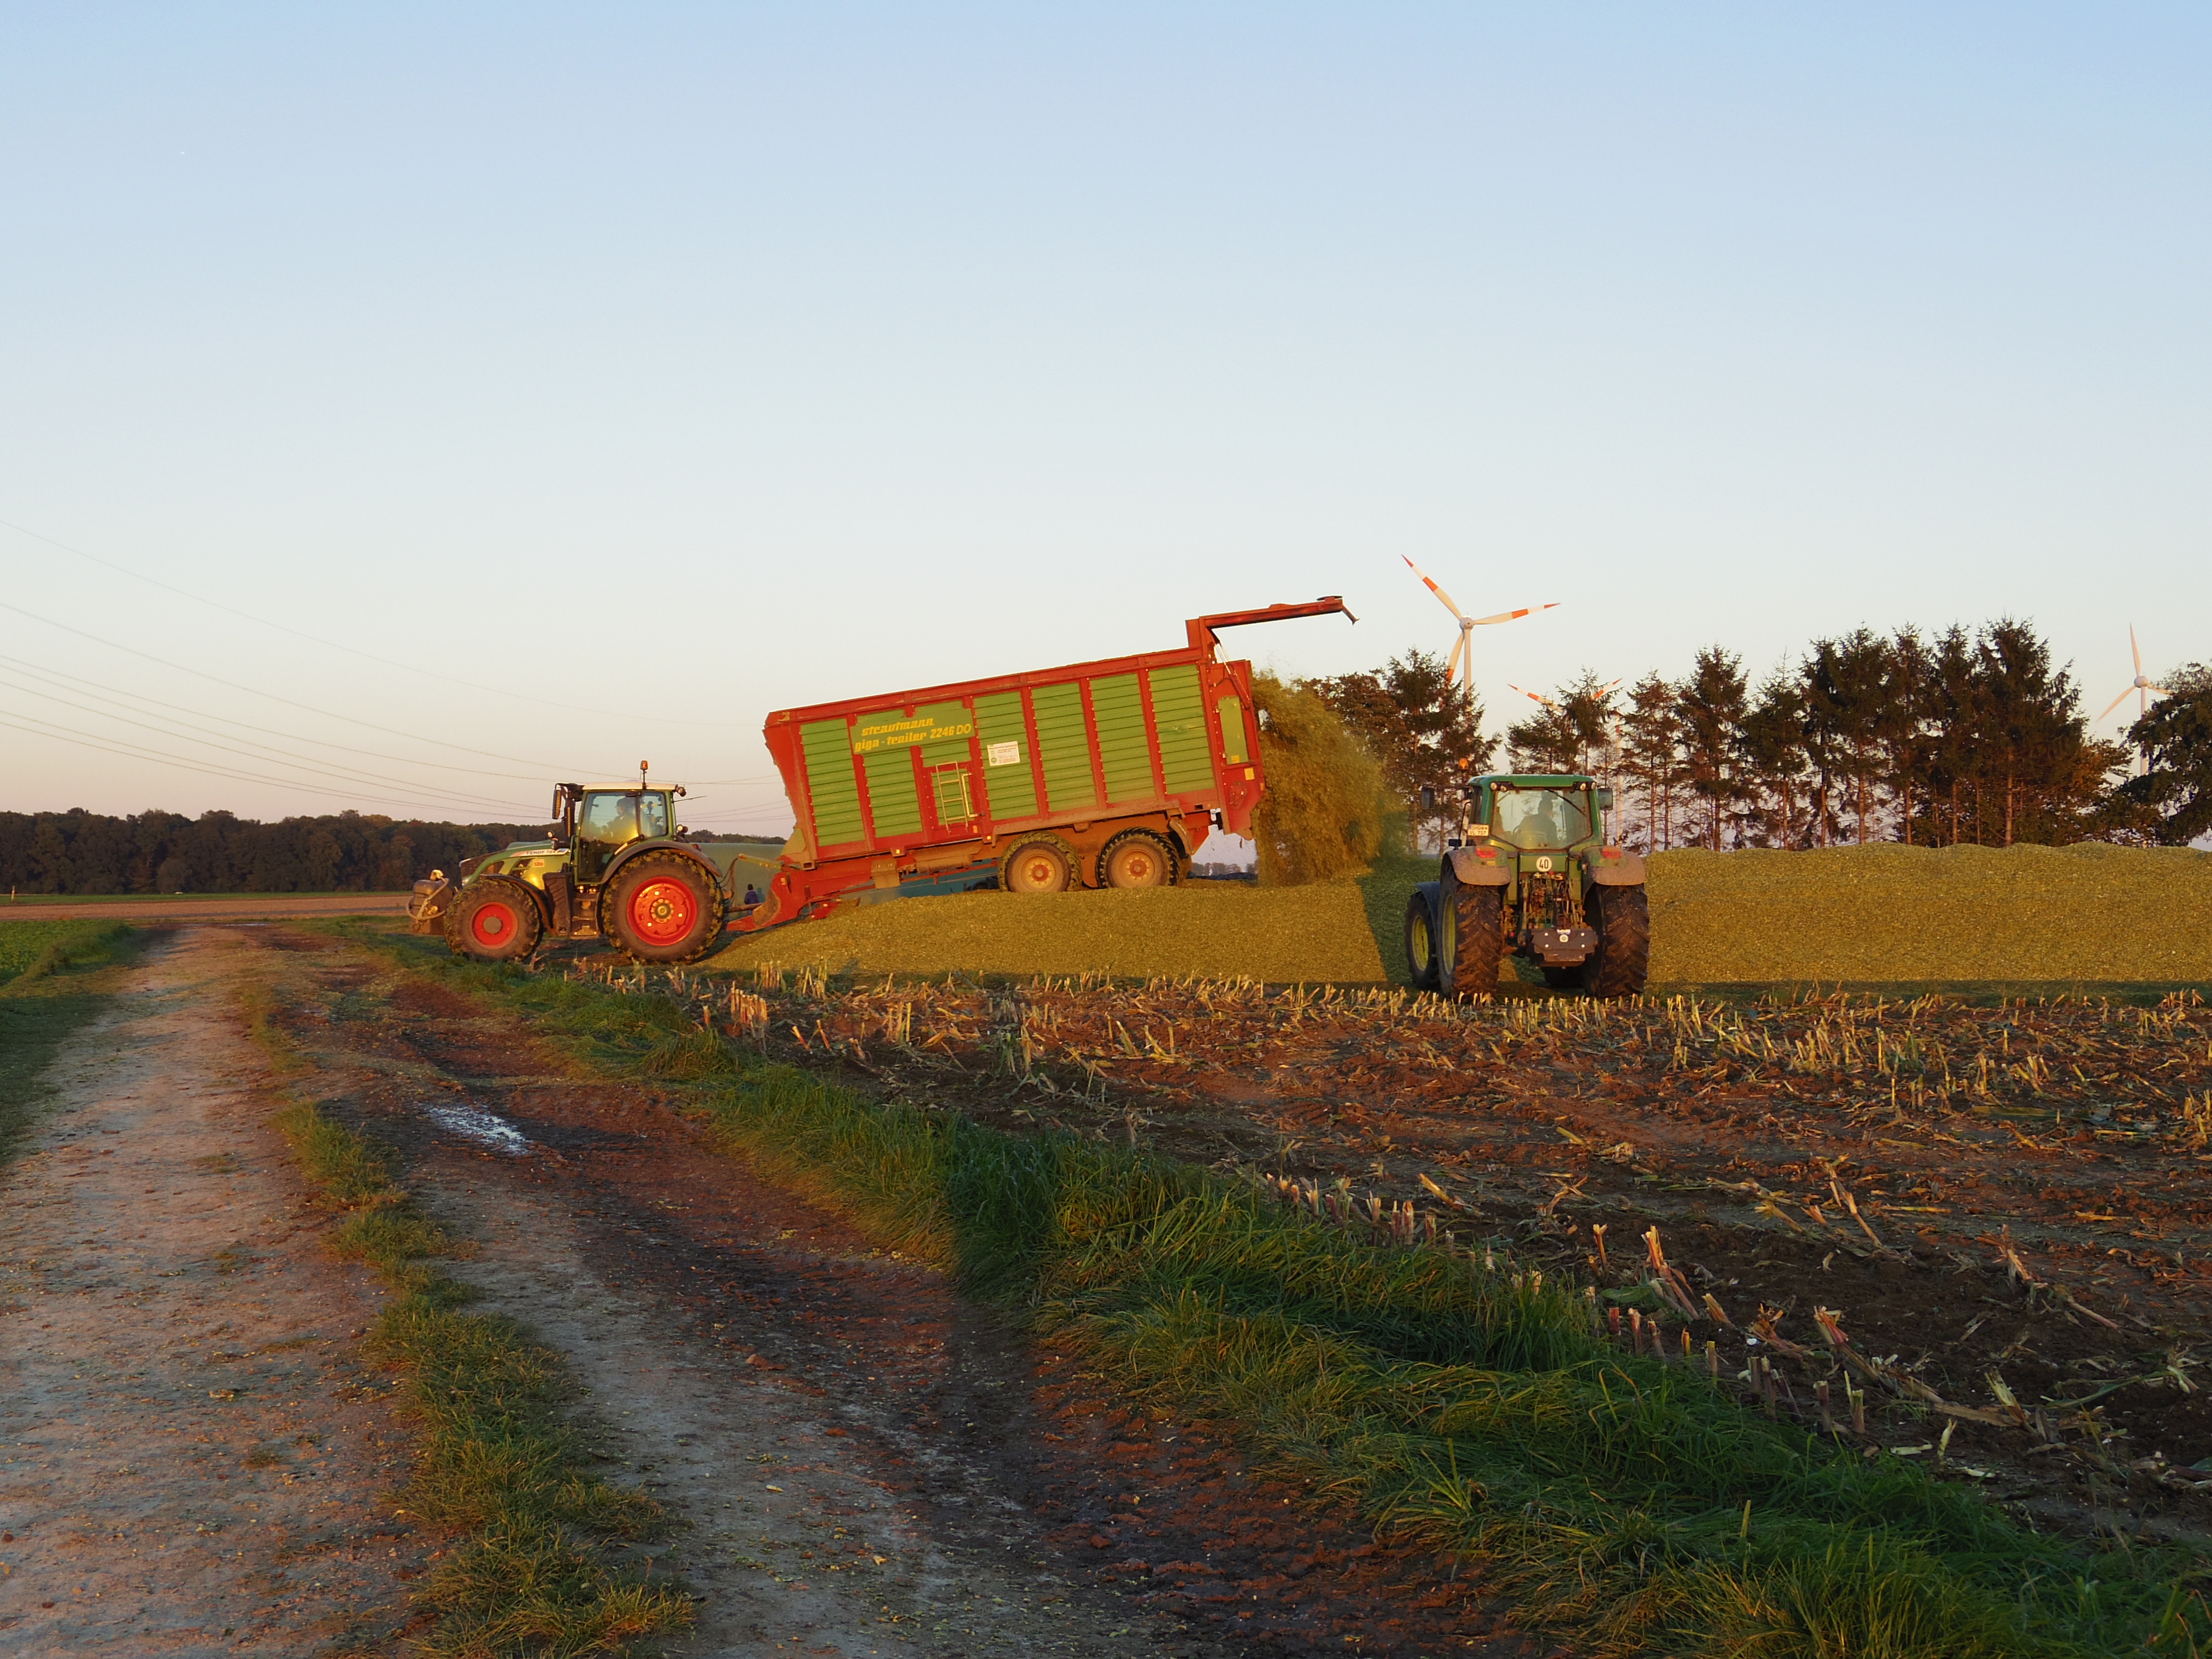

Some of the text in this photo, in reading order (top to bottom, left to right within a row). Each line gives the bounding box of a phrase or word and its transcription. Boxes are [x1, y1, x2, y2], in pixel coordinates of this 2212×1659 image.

[862, 718, 934, 737] strautmann
[854, 739, 879, 752] giga
[887, 732, 927, 745] trailer
[930, 726, 955, 739] 2246
[956, 723, 972, 735] DO
[1539, 859, 1549, 869] 40
